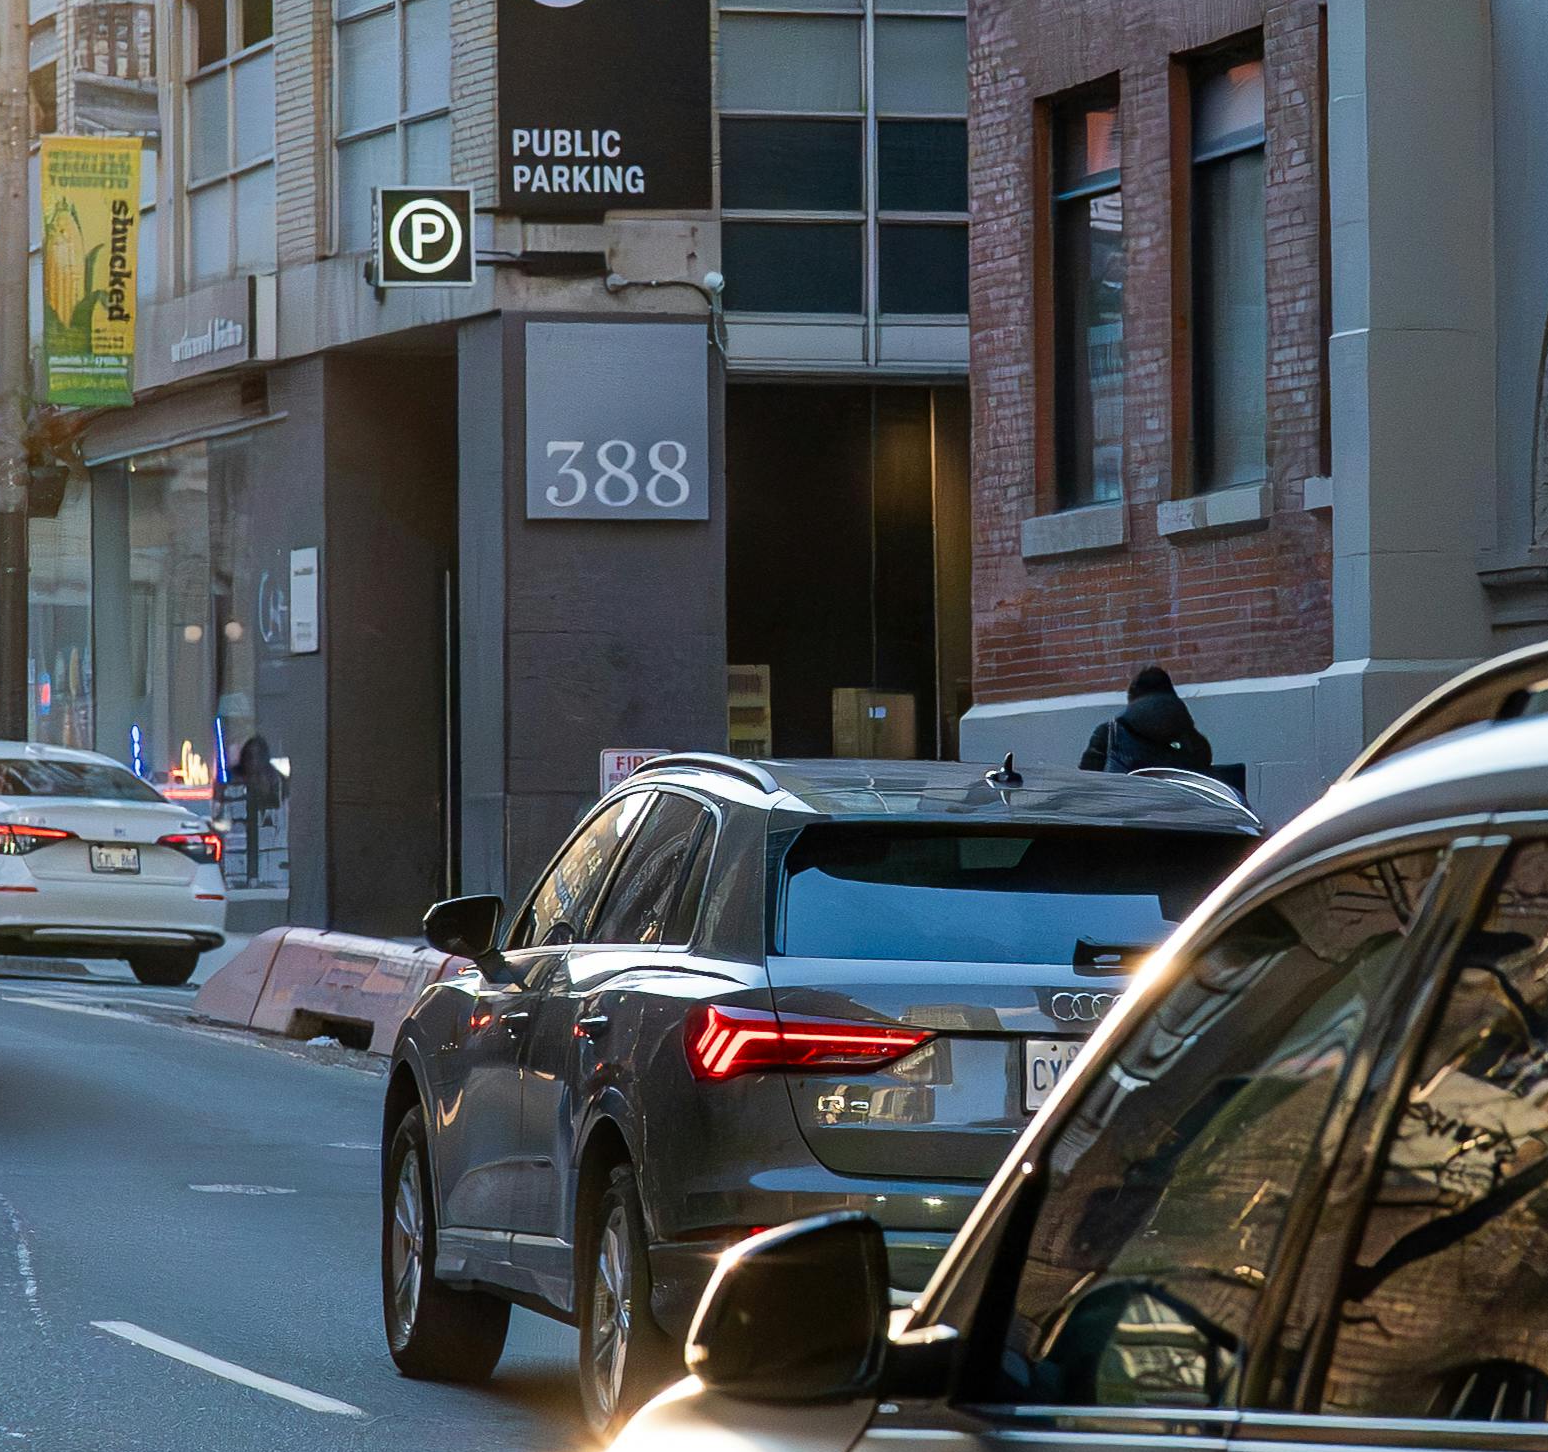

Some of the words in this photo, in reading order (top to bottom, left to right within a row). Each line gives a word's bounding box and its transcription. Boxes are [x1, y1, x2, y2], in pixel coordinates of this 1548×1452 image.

[512, 129, 621, 158] PUBLIC
[512, 165, 646, 194] PARKING
[108, 199, 133, 322] shucked
[545, 440, 690, 508] 388
